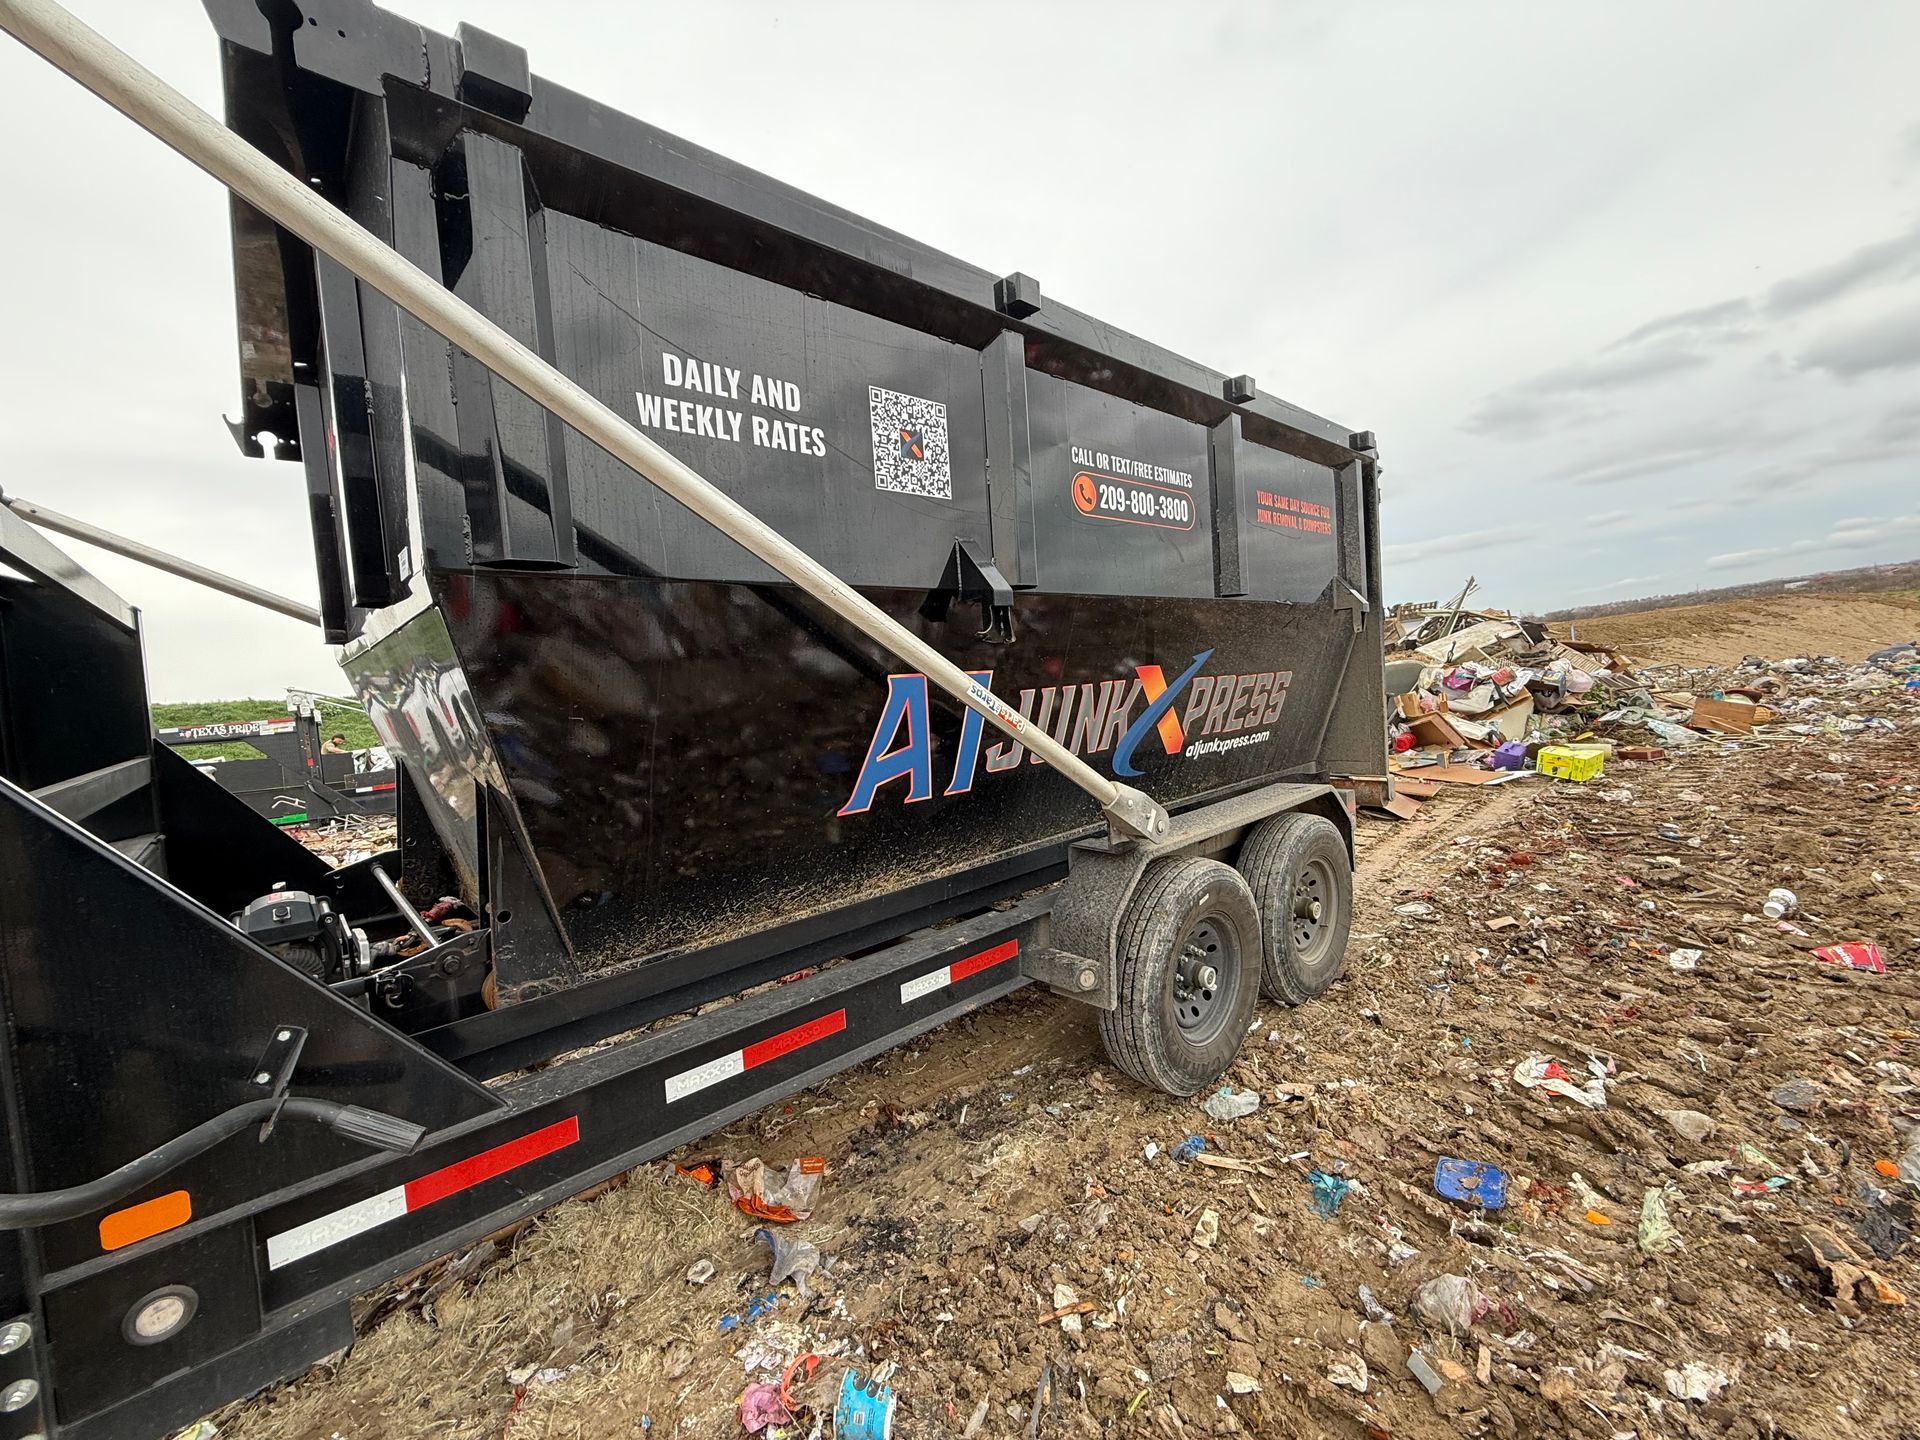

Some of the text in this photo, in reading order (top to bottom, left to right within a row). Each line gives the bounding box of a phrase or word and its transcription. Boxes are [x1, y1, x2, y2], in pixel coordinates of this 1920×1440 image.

[662, 352, 801, 413] DAILY AND
[635, 391, 826, 457] WEEKLY RATES
[1071, 446, 1193, 488] CALL OR TEXT/FREE ESTIMATES
[1099, 484, 1189, 522] 209-800-3800
[1257, 490, 1273, 506] YOUR
[1274, 495, 1289, 510] SAME
[1301, 501, 1320, 517] SOURCE
[1257, 508, 1272, 525] JUNK
[1272, 511, 1298, 529] REMOVAL
[1303, 518, 1332, 535] DUMPSTERS
[190, 725, 227, 739] TEXAS
[228, 722, 260, 735] PRIDE
[1185, 730, 1270, 760] a1junkxpress.com
